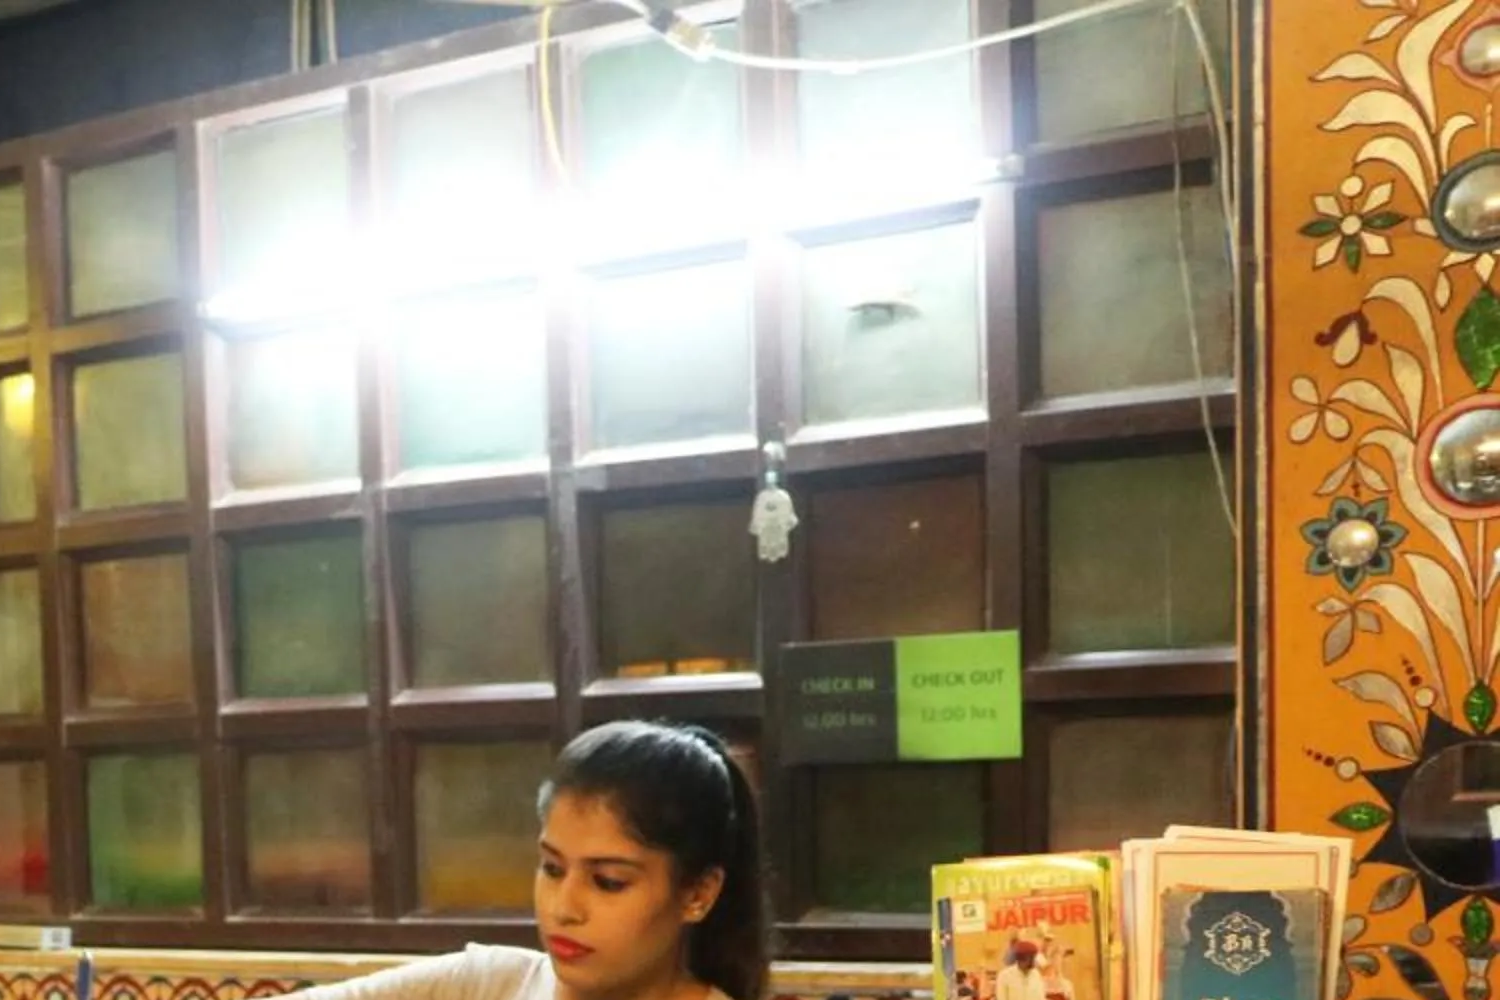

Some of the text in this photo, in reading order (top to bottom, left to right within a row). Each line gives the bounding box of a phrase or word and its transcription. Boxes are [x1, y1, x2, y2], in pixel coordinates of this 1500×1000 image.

[803, 676, 876, 694] CHECK IN
[911, 669, 1005, 689] CHECK OUT
[987, 902, 1091, 931] JAIPUR
